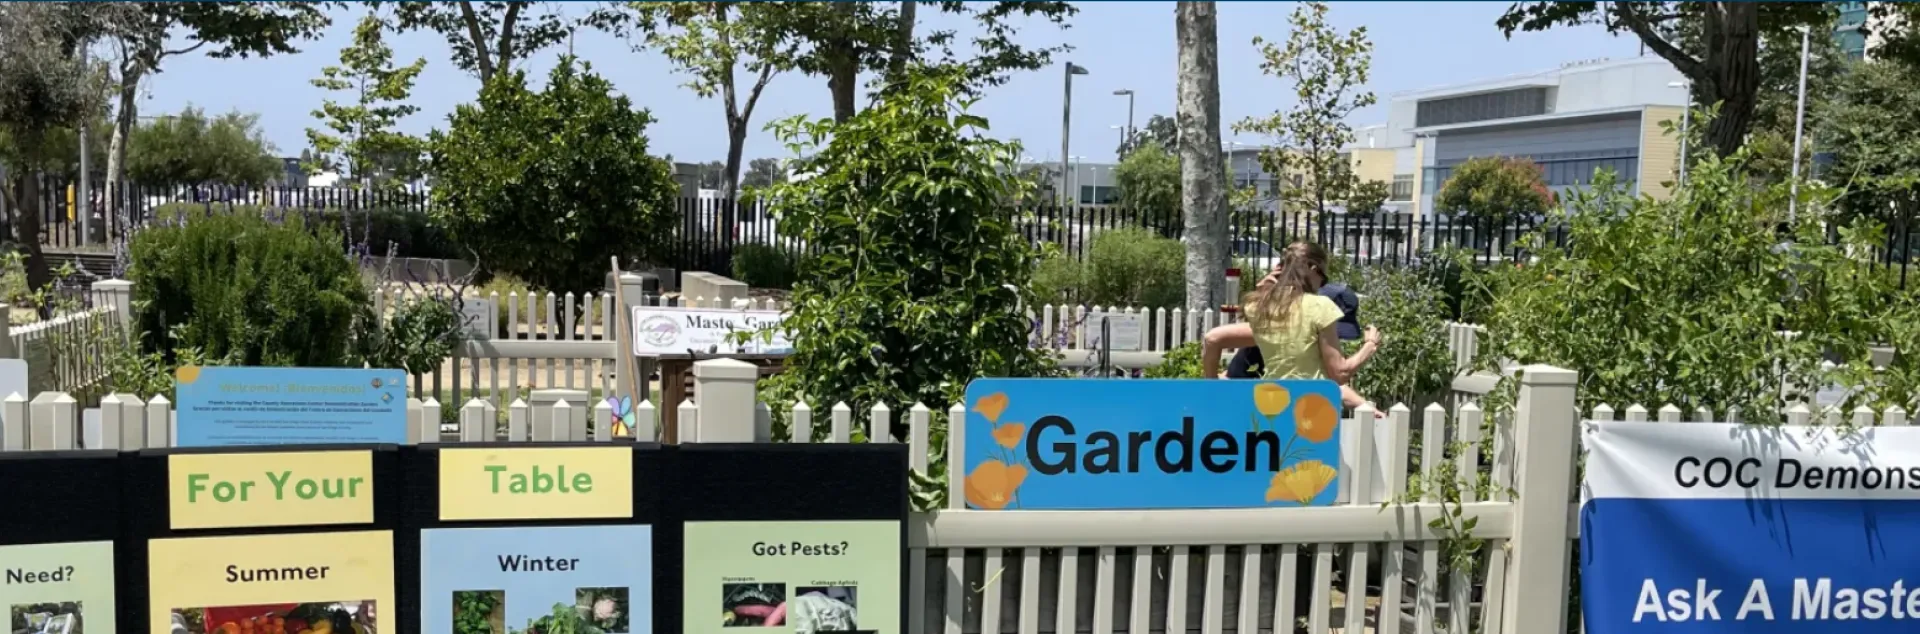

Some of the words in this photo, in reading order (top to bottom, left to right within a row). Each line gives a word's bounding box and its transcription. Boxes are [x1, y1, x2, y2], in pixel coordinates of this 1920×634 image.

[686, 314, 737, 330] Maste
[1026, 415, 1281, 476] Garden
[483, 464, 593, 494] Table
[1674, 456, 1763, 489] COC
[1774, 458, 1920, 490] Demons
[187, 473, 256, 503] For
[265, 470, 364, 501] Your
[752, 541, 787, 557] Got
[791, 540, 849, 557] Pests?
[6, 565, 75, 585] Need?
[226, 564, 330, 583] Summer
[497, 554, 580, 572] Winter
[1632, 578, 1722, 623] Ask
[1735, 578, 1775, 620] A
[1791, 577, 1920, 620] Maste
